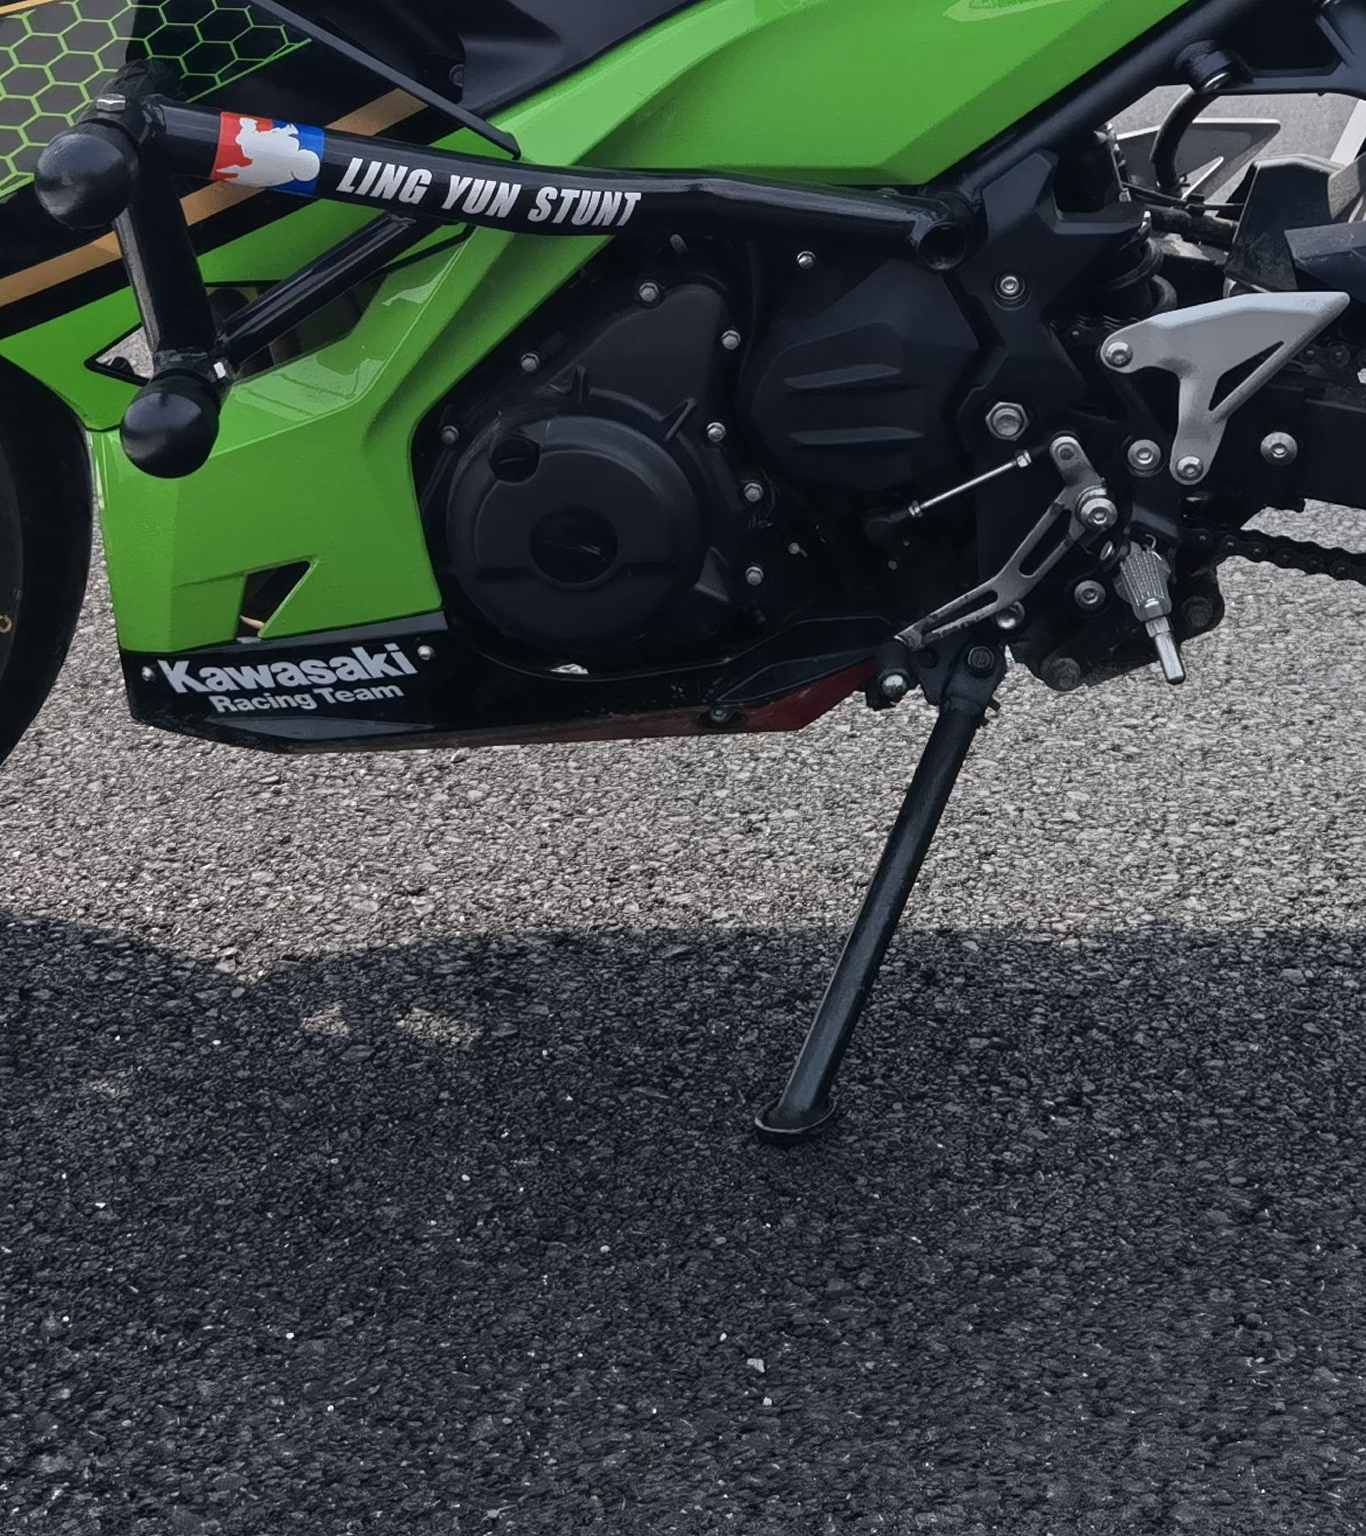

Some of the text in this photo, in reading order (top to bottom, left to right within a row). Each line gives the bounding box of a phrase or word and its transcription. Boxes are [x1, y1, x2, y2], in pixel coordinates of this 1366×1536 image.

[336, 157, 642, 227] LING YUN STUNT
[157, 643, 418, 694] Kawasaki
[208, 684, 404, 713] Racing Team
